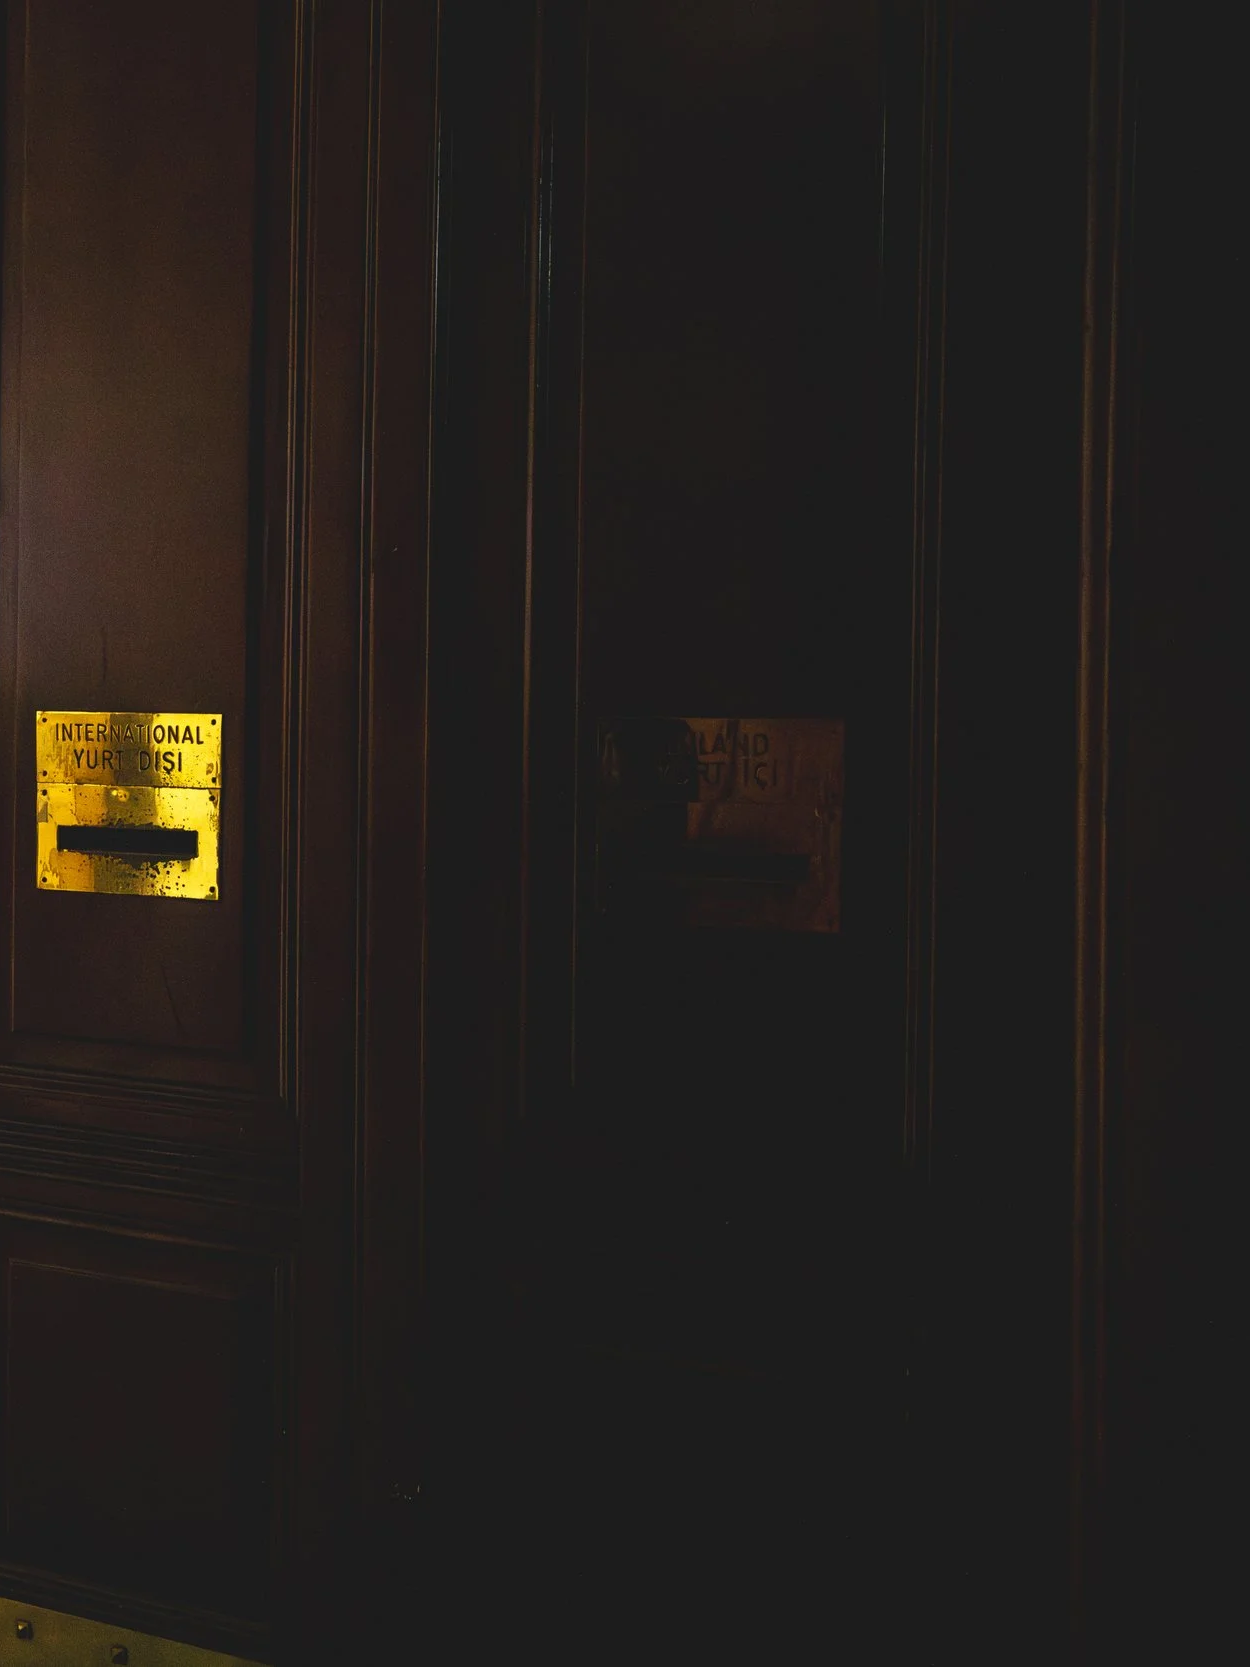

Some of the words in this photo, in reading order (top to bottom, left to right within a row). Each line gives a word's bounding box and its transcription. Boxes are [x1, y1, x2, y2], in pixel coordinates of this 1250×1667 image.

[55, 722, 205, 746] INTERNATIONAL
[73, 749, 124, 771] YURT
[138, 750, 183, 775] DIŞI
